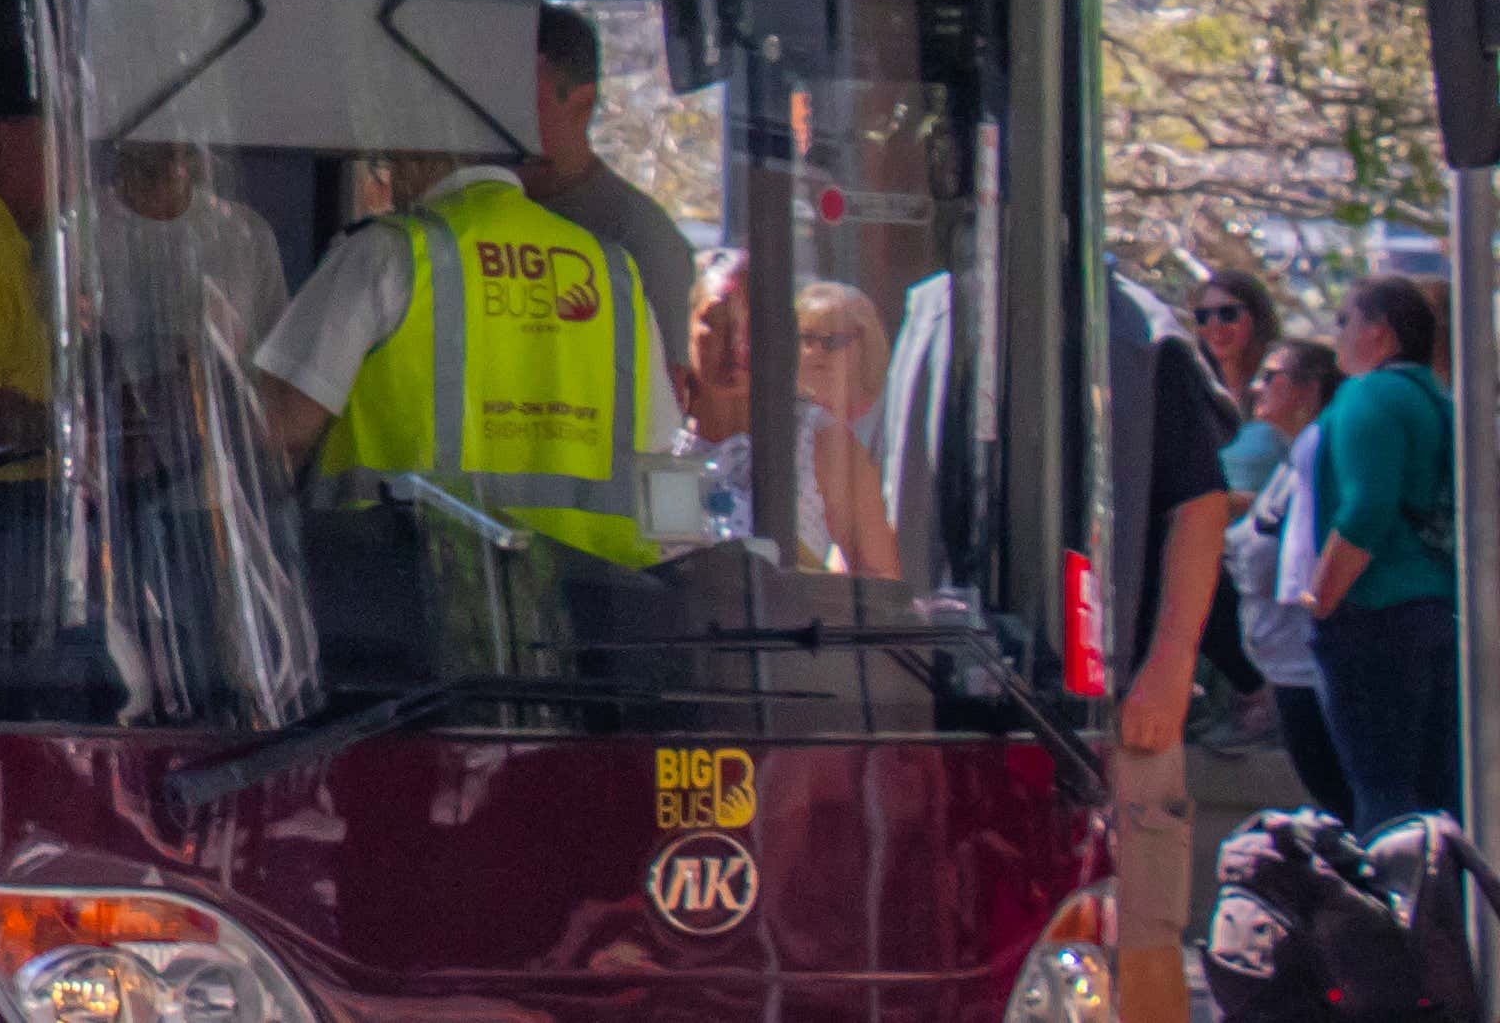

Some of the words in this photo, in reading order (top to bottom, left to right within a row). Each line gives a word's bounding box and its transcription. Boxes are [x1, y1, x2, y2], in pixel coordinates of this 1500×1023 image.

[476, 241, 546, 280] BIG
[484, 280, 552, 318] BUS
[655, 748, 712, 790] BIG
[656, 791, 714, 828] BUS
